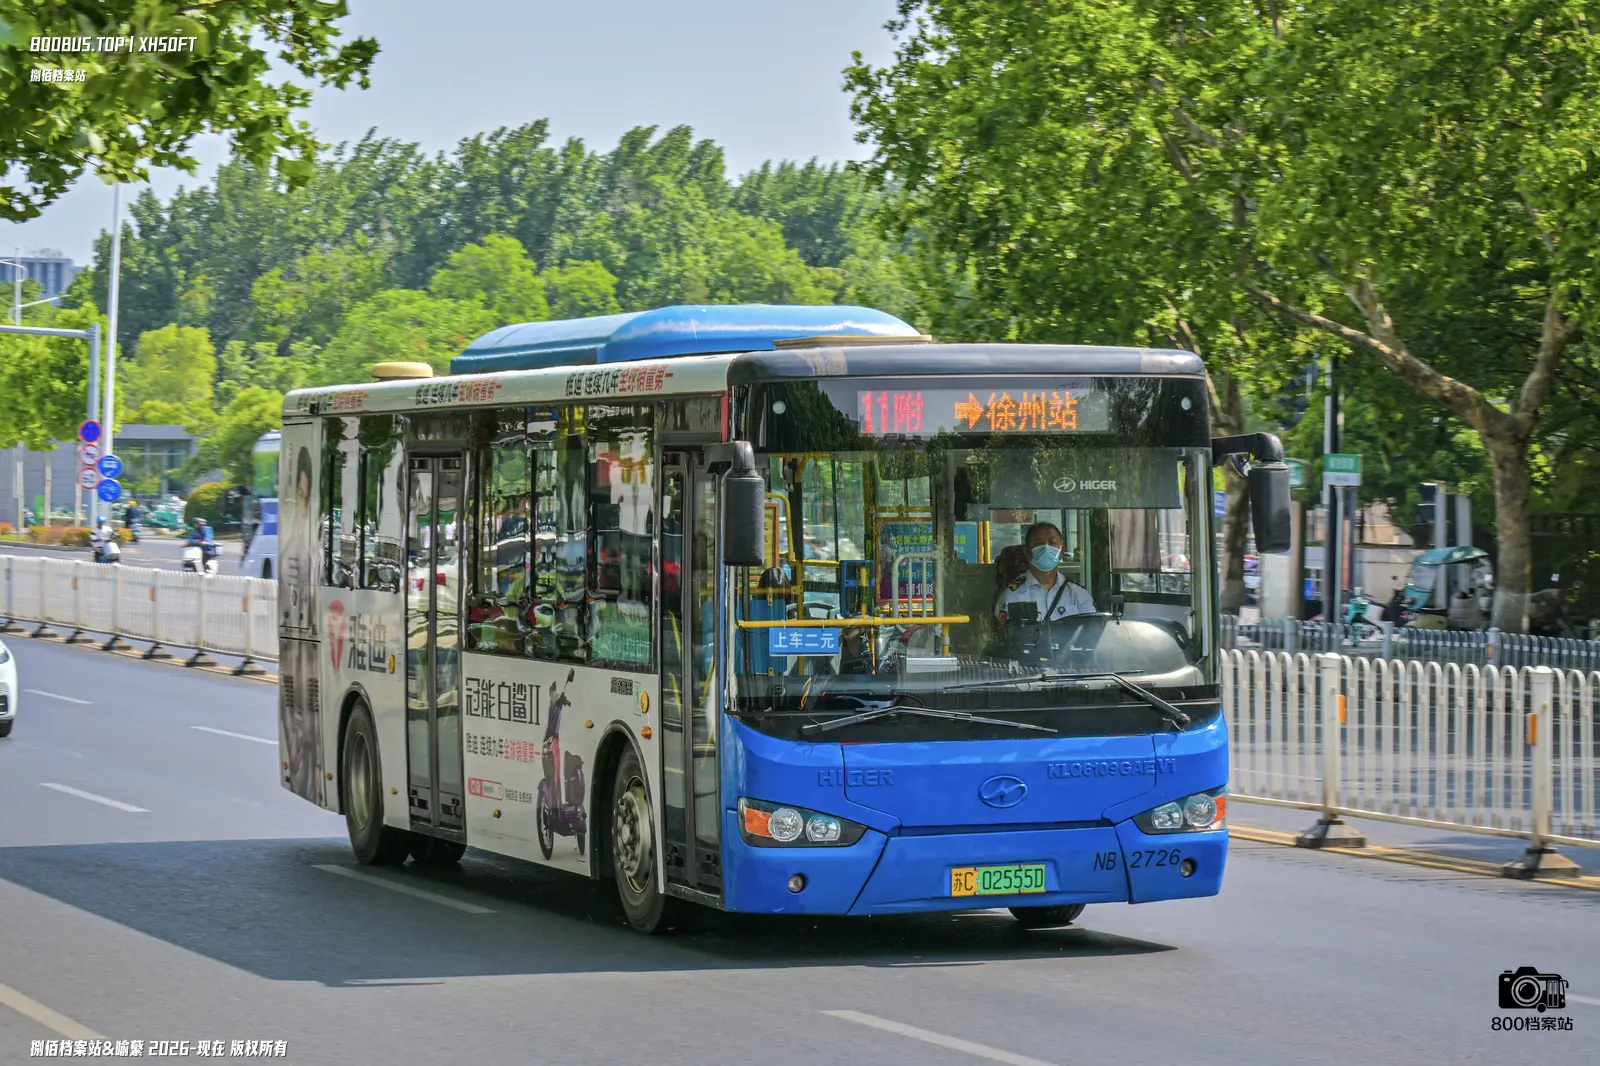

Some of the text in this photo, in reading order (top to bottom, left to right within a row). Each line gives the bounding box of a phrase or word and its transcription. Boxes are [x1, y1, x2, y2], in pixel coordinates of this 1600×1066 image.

[861, 390, 1079, 433] 11附 徐州站
[1079, 480, 1117, 490] HIGER
[348, 614, 387, 673] 雅迪
[773, 632, 836, 649] 上车二元
[818, 769, 894, 787] HIGER
[1093, 848, 1181, 871] NB 2726
[952, 867, 1045, 893] 苏C 02555D
